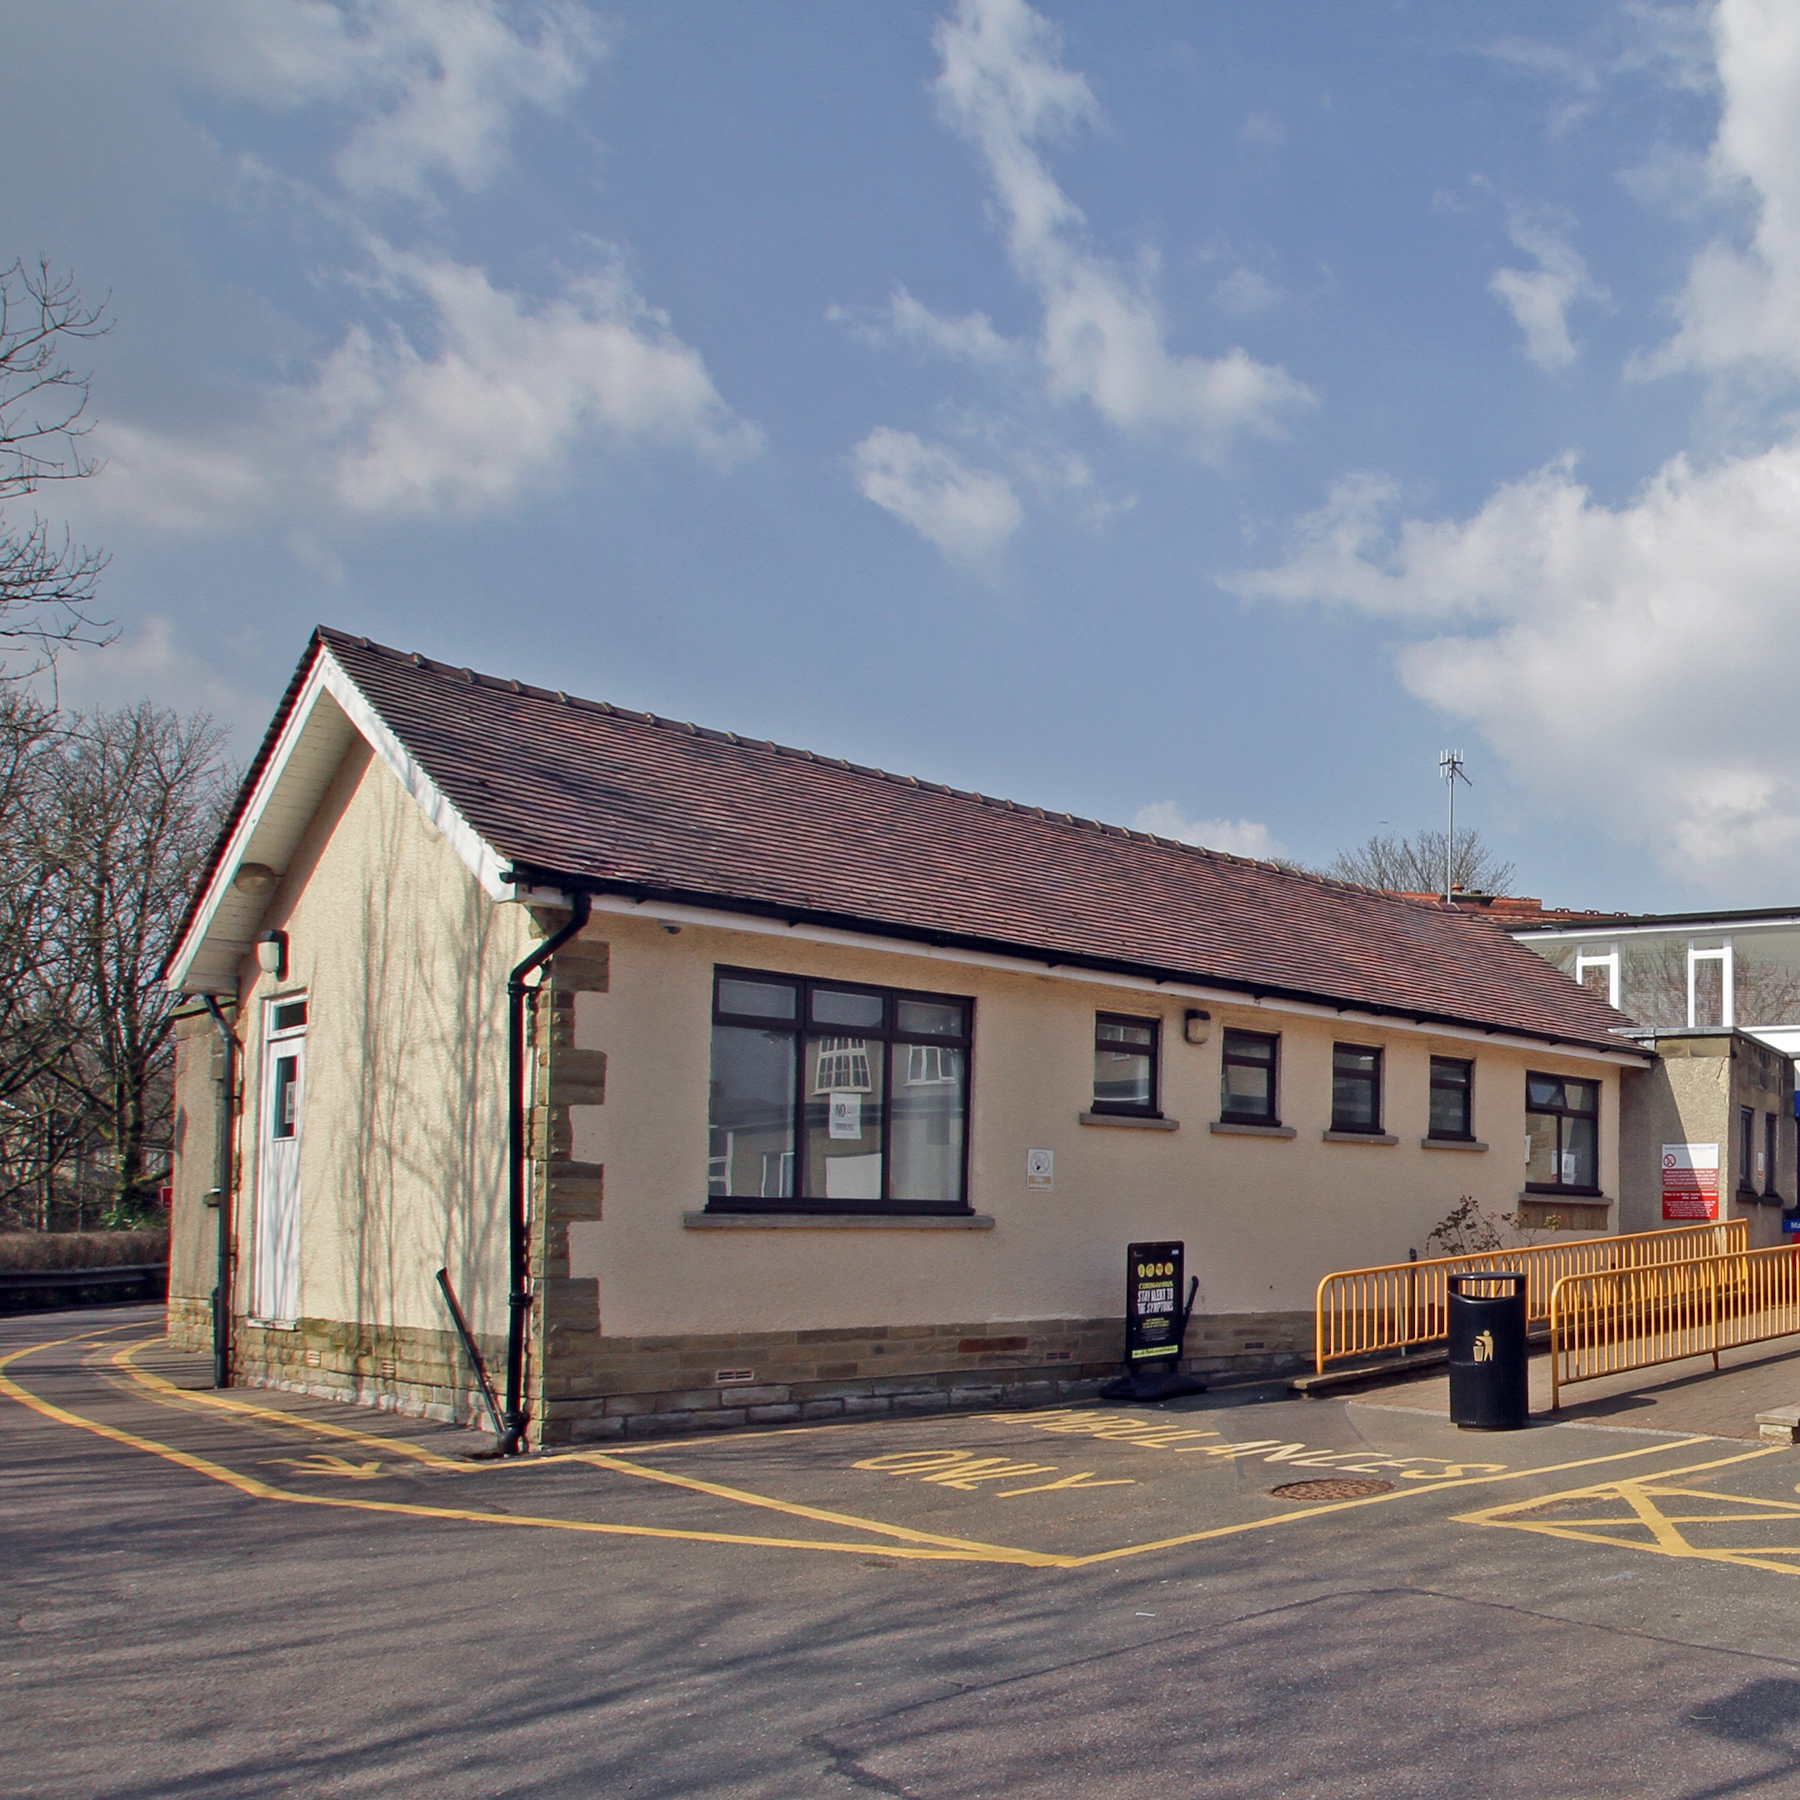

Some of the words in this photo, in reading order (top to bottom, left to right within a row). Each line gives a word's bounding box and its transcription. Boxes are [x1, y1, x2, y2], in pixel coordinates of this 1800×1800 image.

[1151, 1288, 1166, 1302] ALERT
[1167, 1287, 1174, 1300] TO
[850, 1450, 1136, 1499] ONLY
